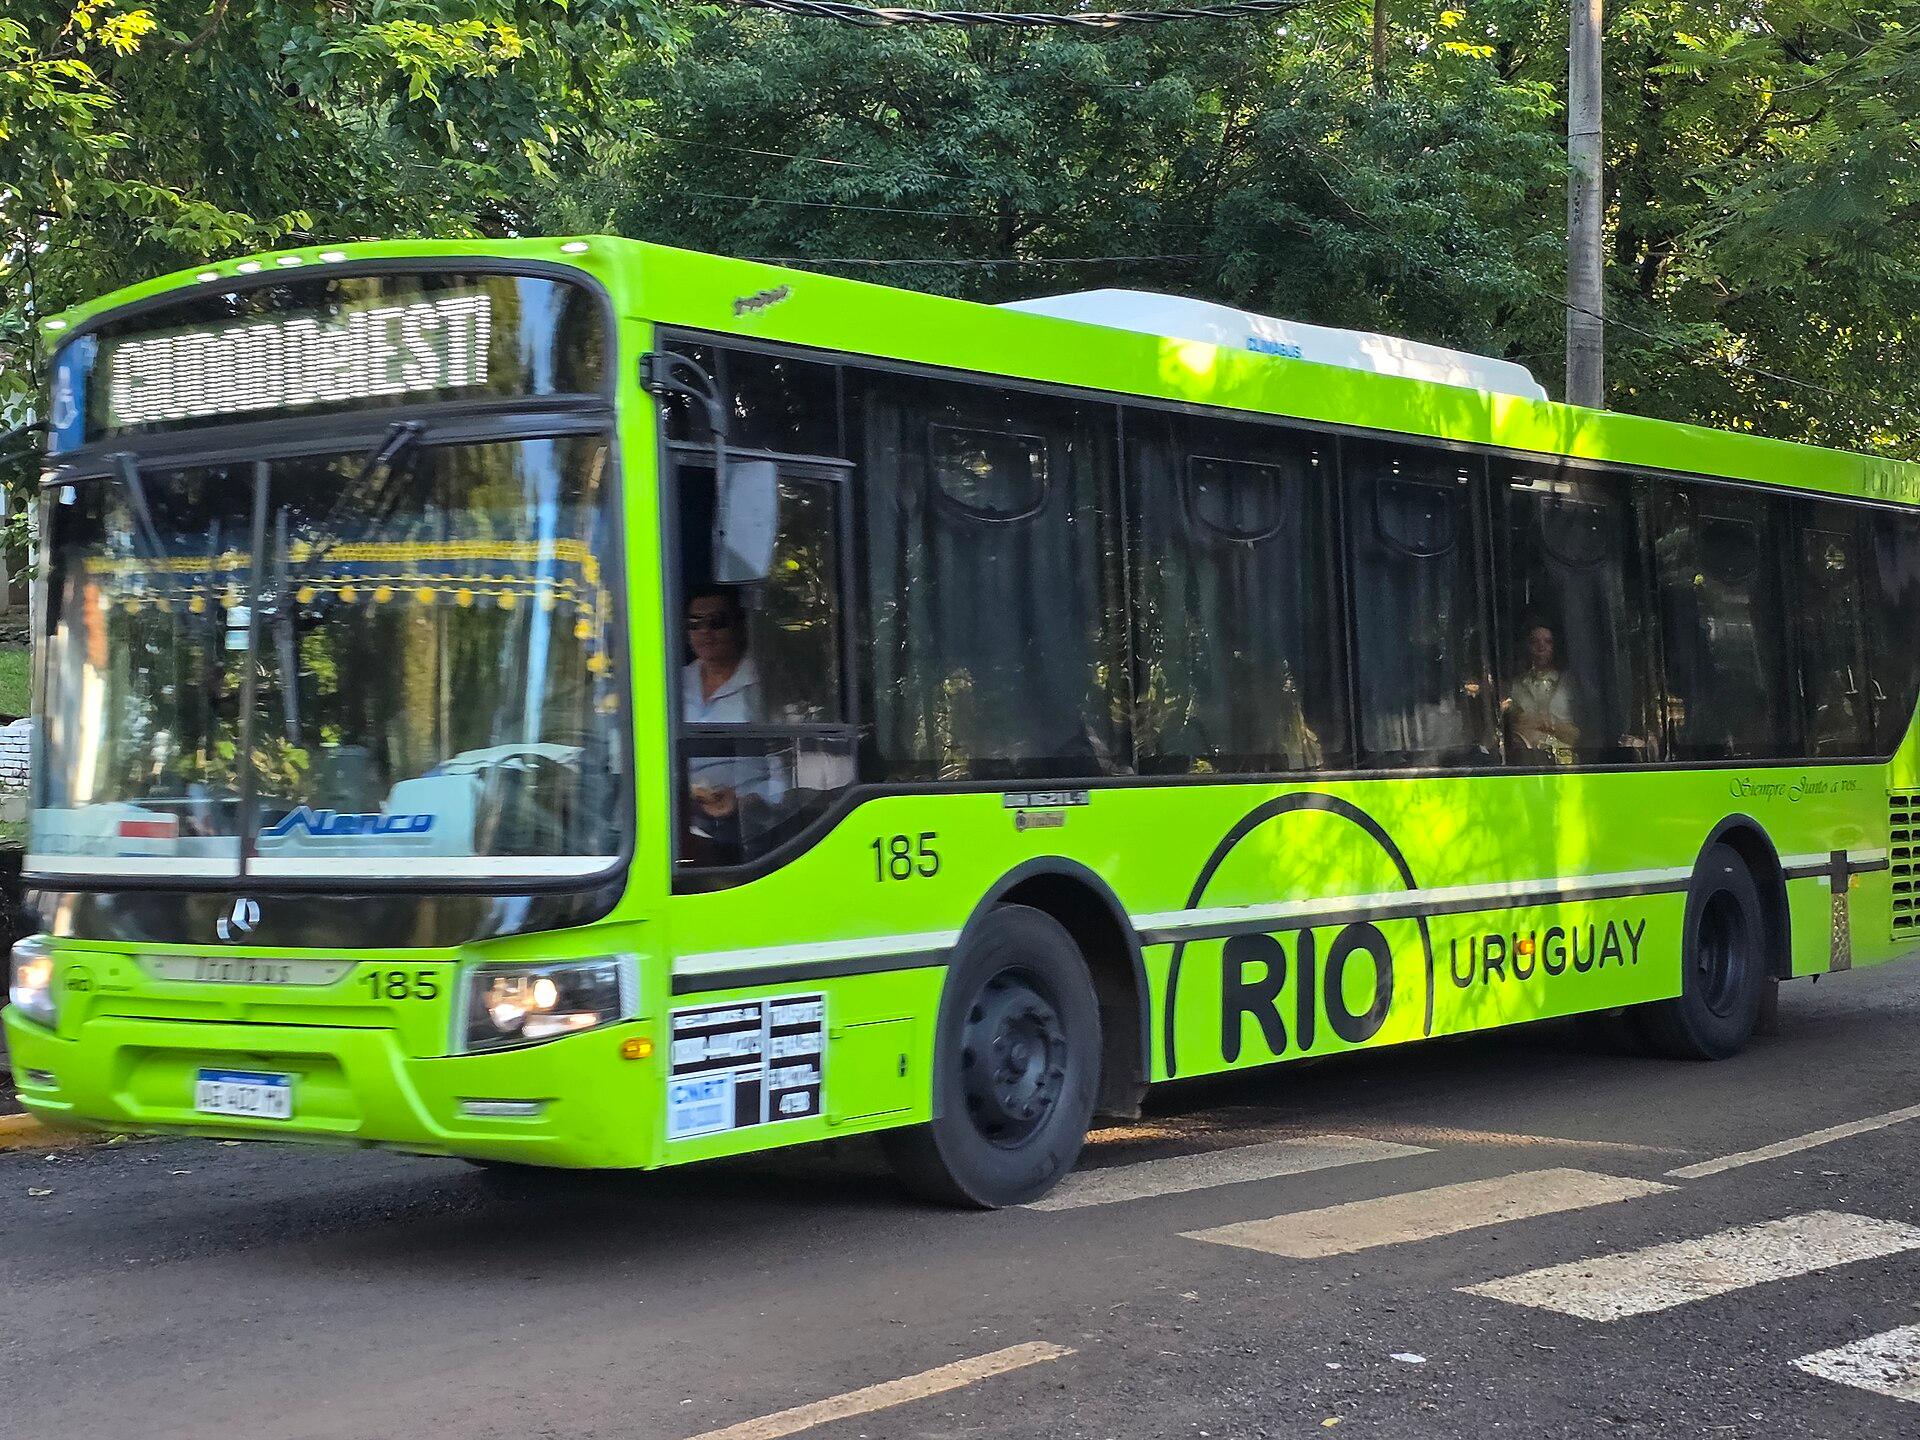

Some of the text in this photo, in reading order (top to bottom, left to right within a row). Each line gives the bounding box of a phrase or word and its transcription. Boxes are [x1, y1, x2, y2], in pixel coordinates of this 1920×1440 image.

[1729, 777, 1786, 802] Siempre
[1789, 776, 1828, 802] Junto
[872, 831, 939, 882] 185
[368, 970, 439, 1000] 185
[1221, 917, 1647, 1063] RIO URUGUAY
